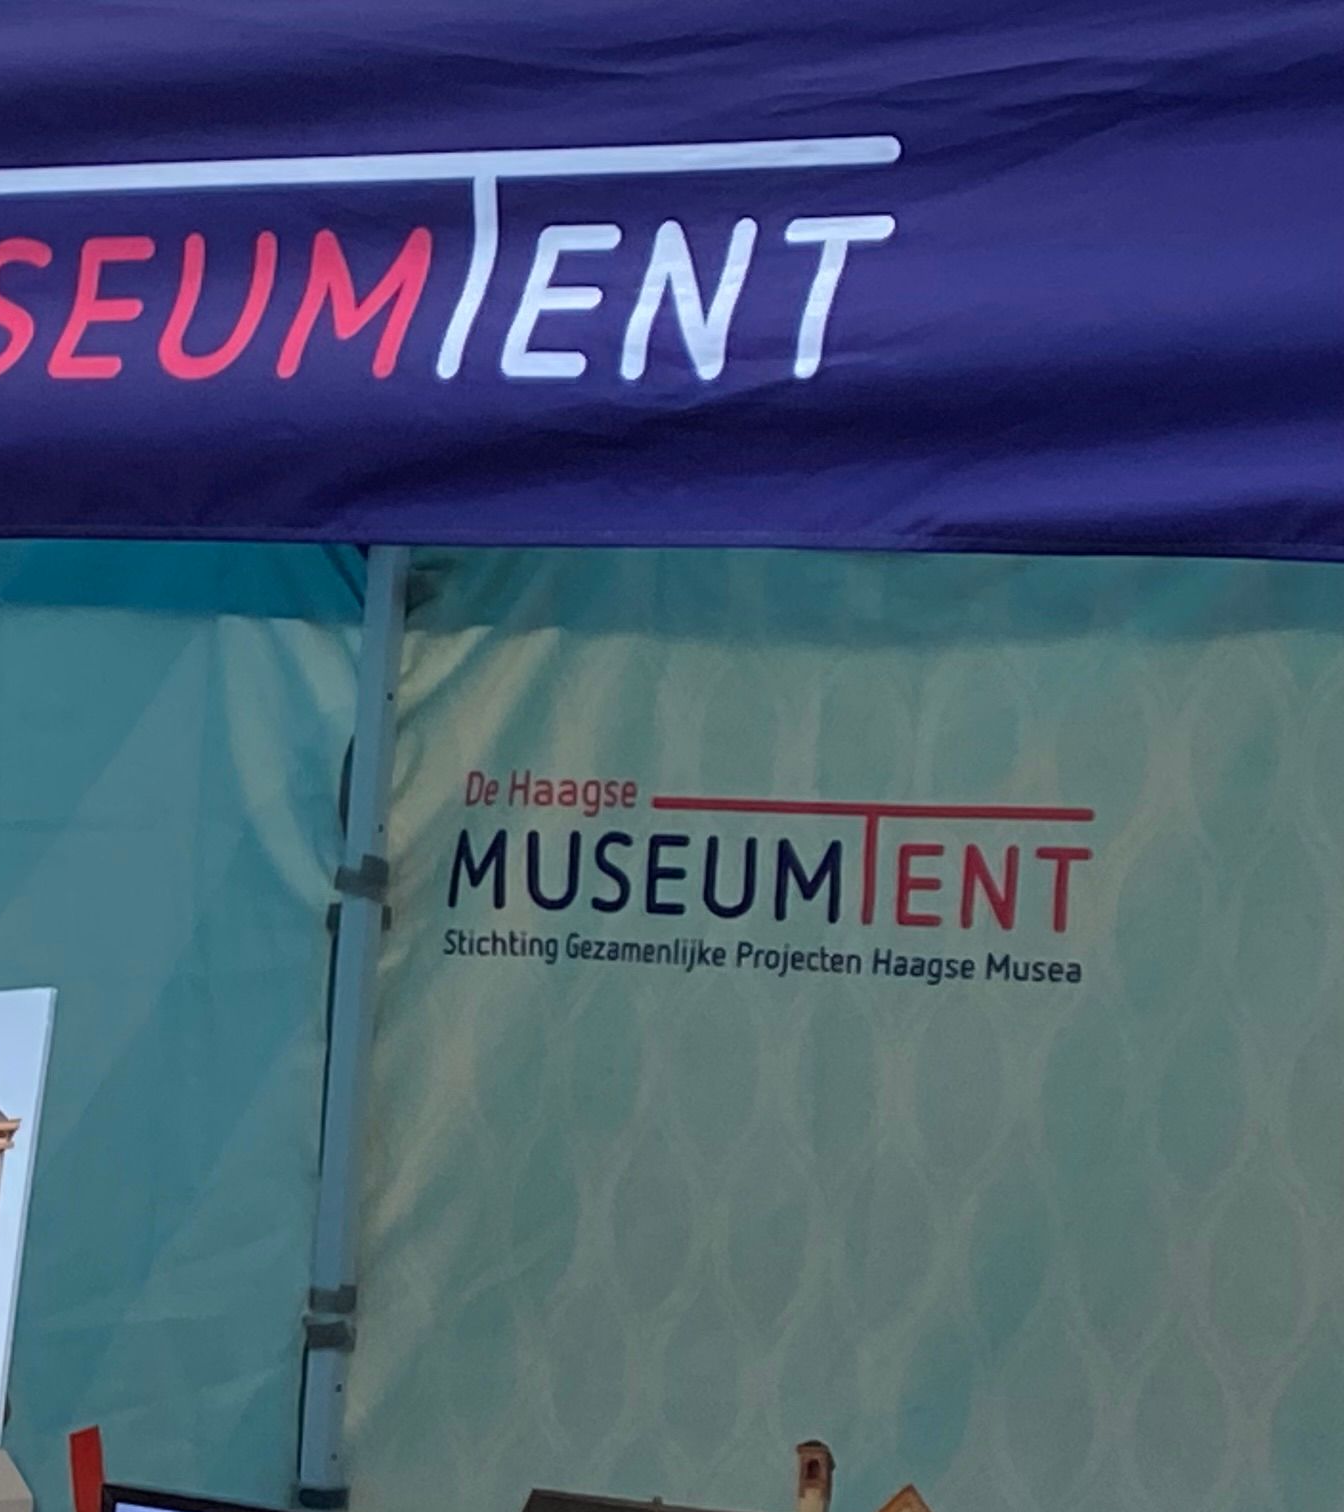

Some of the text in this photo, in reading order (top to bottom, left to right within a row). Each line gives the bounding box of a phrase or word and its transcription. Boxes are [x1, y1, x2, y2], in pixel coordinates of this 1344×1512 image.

[465, 770, 638, 817] De Haagse
[443, 929, 1083, 985] Stichting Gezamenlijke Projecten Haagse Musea
